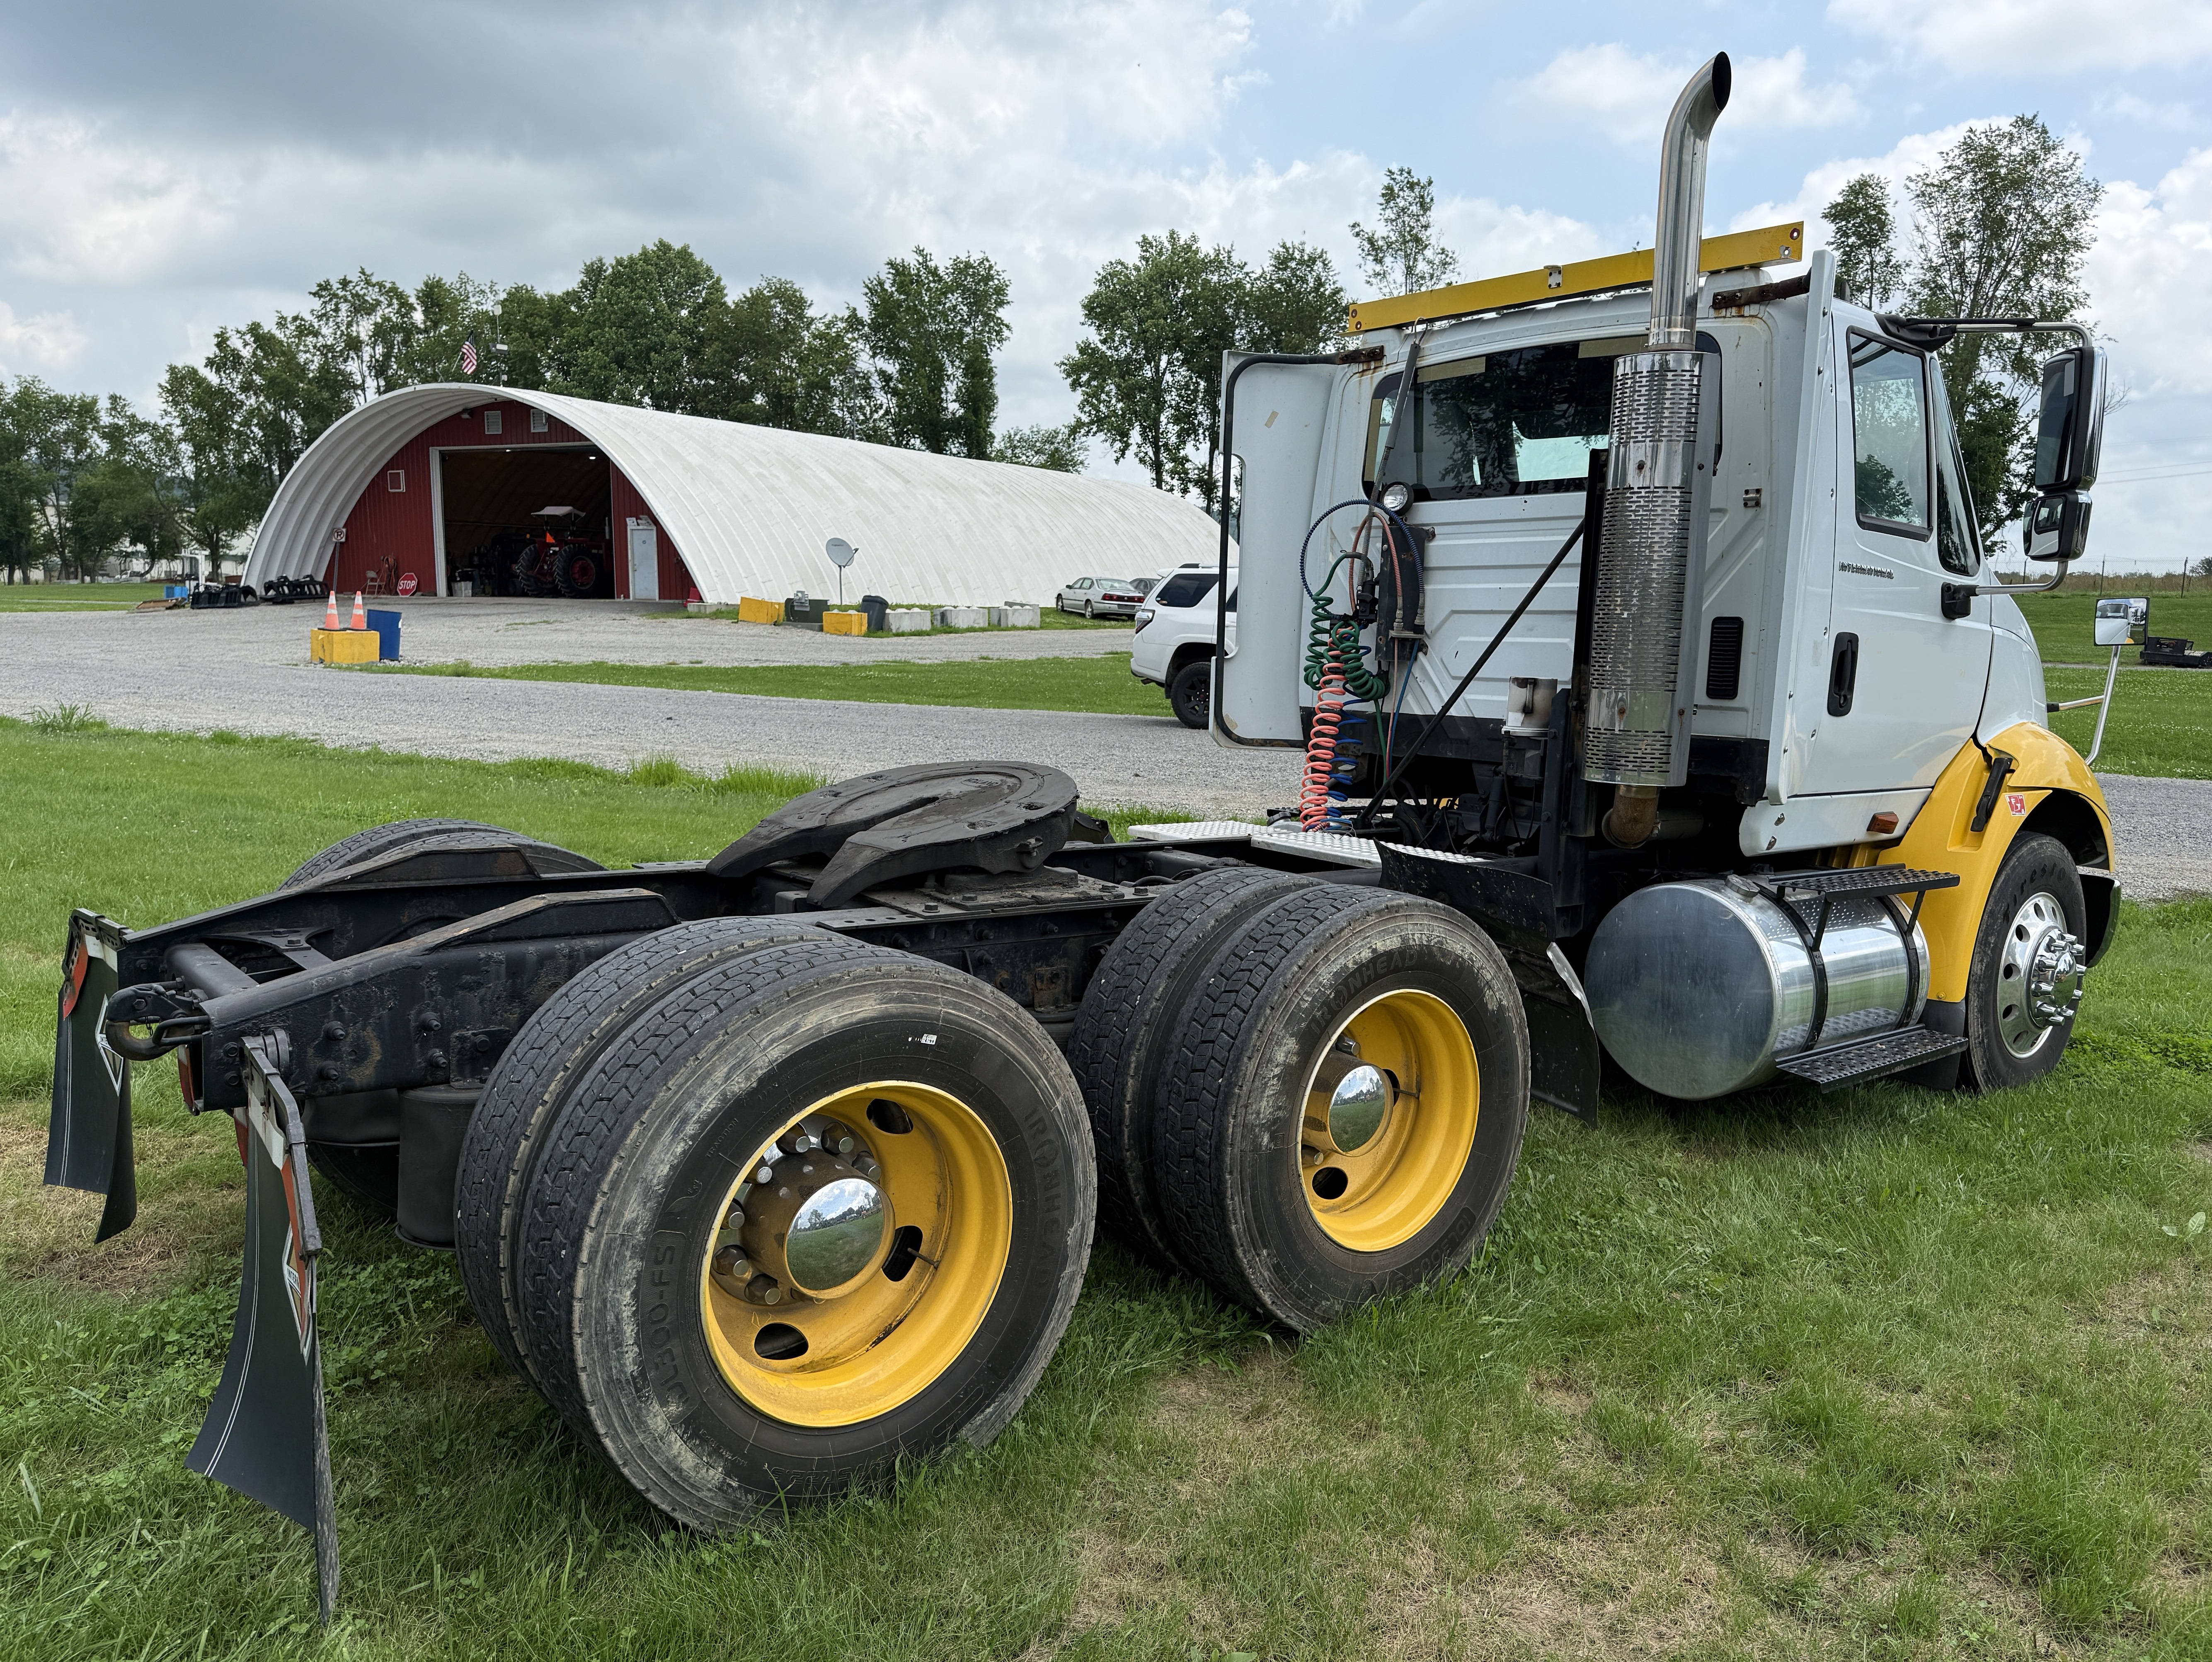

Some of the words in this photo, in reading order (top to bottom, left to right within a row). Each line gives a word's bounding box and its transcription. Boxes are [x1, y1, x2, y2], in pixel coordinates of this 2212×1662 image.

[399, 580, 416, 590] STOP
[1839, 561, 1894, 579] INTERNATIONAL
[1310, 949, 1418, 1035] IRONHEAD
[705, 1117, 739, 1158] TRACTION
[1023, 1108, 1062, 1288] IRONHEAD
